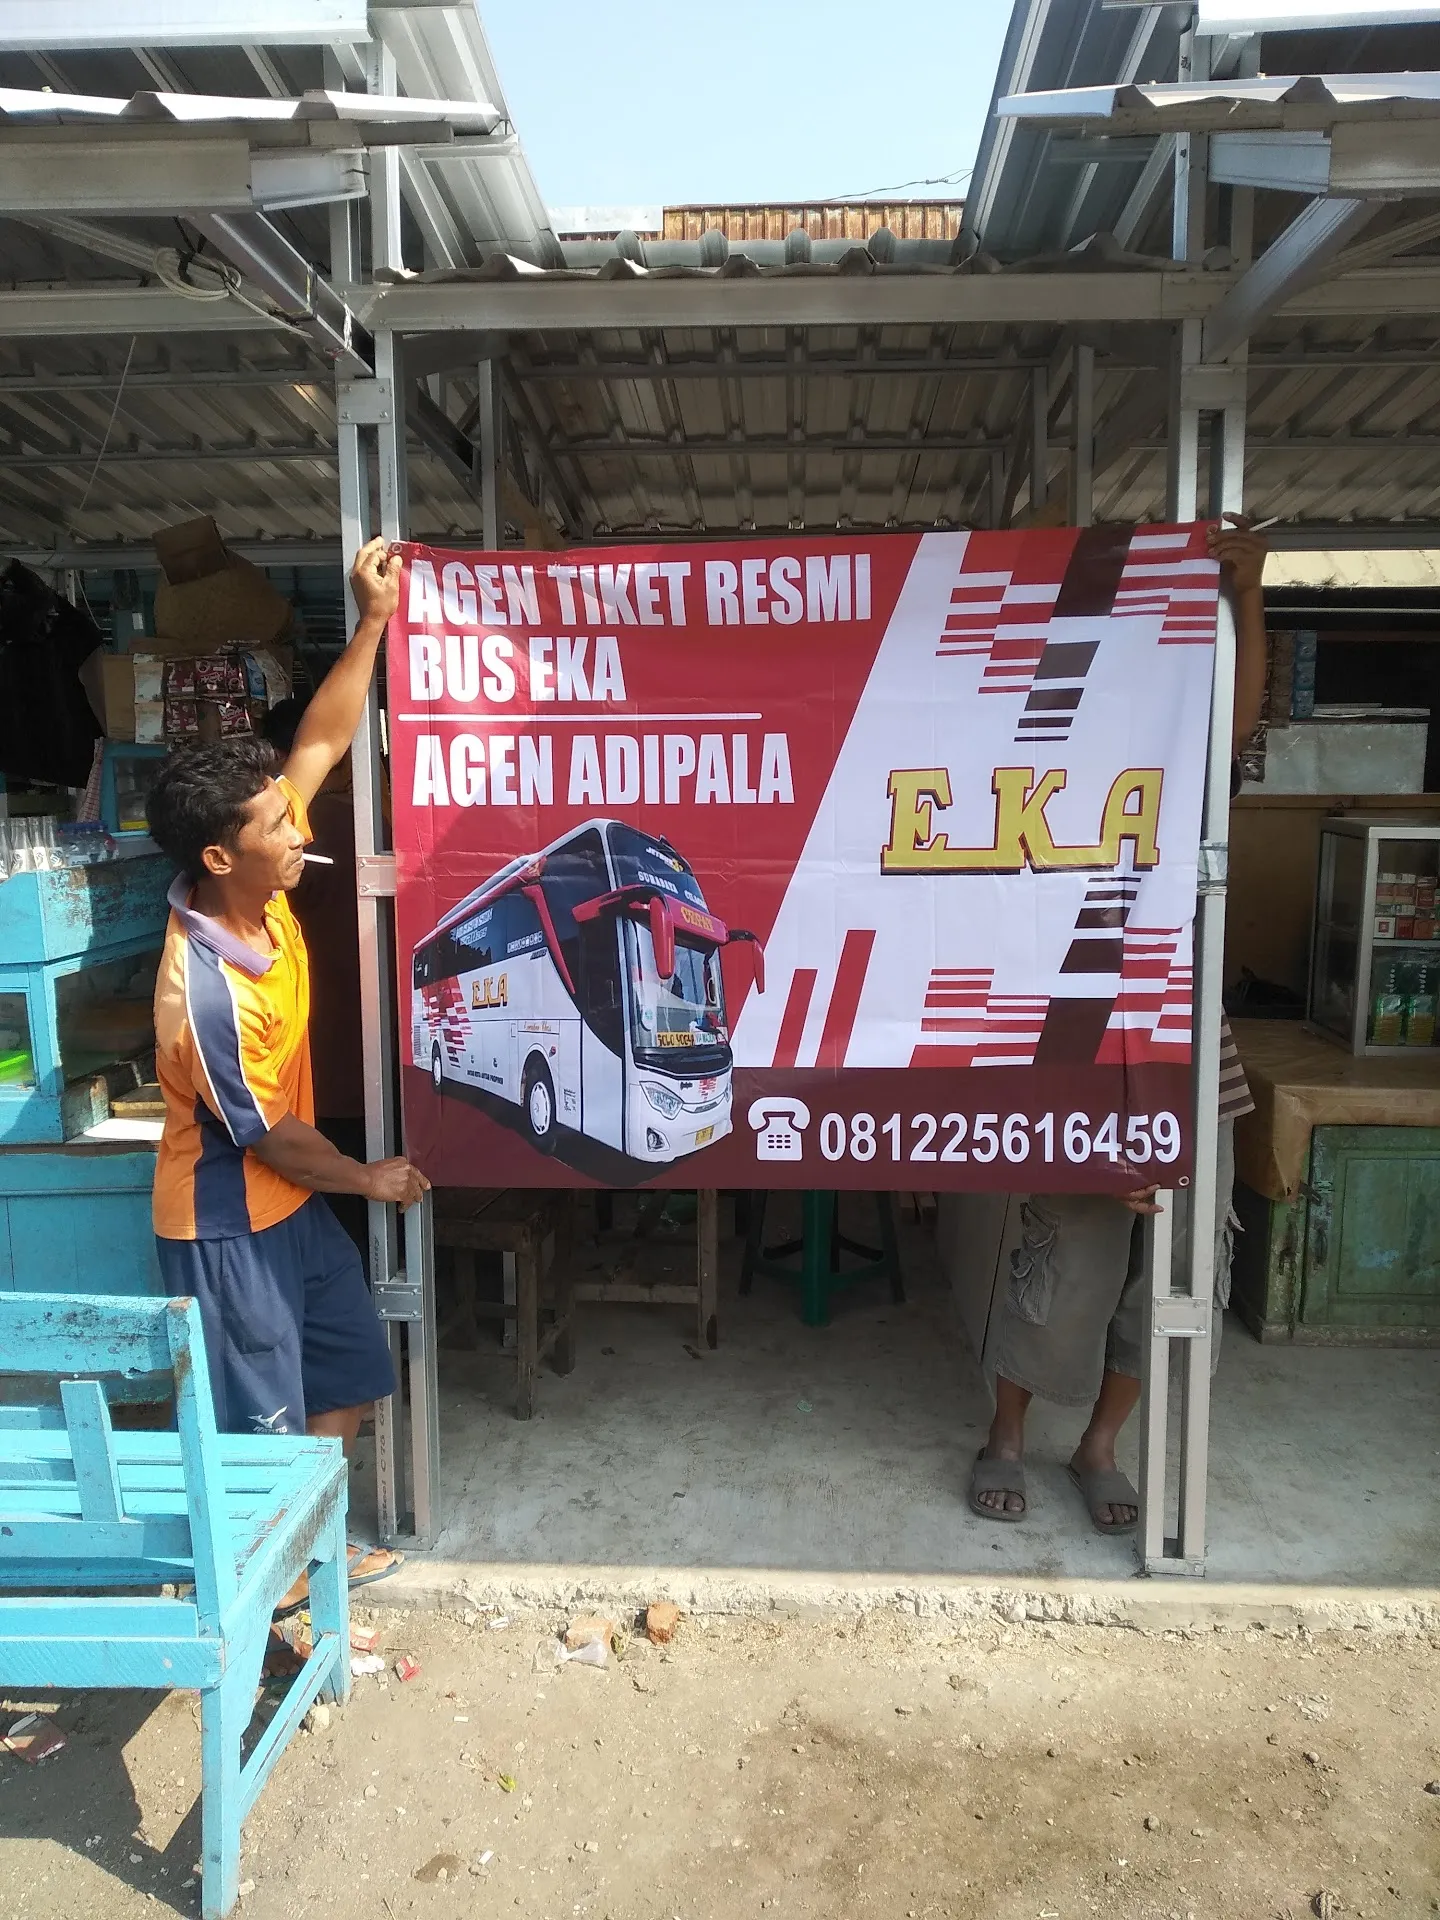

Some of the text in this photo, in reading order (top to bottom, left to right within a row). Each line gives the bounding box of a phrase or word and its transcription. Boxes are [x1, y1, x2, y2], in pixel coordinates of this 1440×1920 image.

[407, 553, 874, 626] AGEN TIKET RESMI
[408, 634, 628, 703] BUS EKA
[411, 732, 796, 807] AGEN ADIPALA
[880, 767, 1165, 876] EKA
[637, 870, 679, 895] SURABAYA
[471, 972, 509, 1011] EKA
[818, 1110, 1183, 1163] 081225616459
